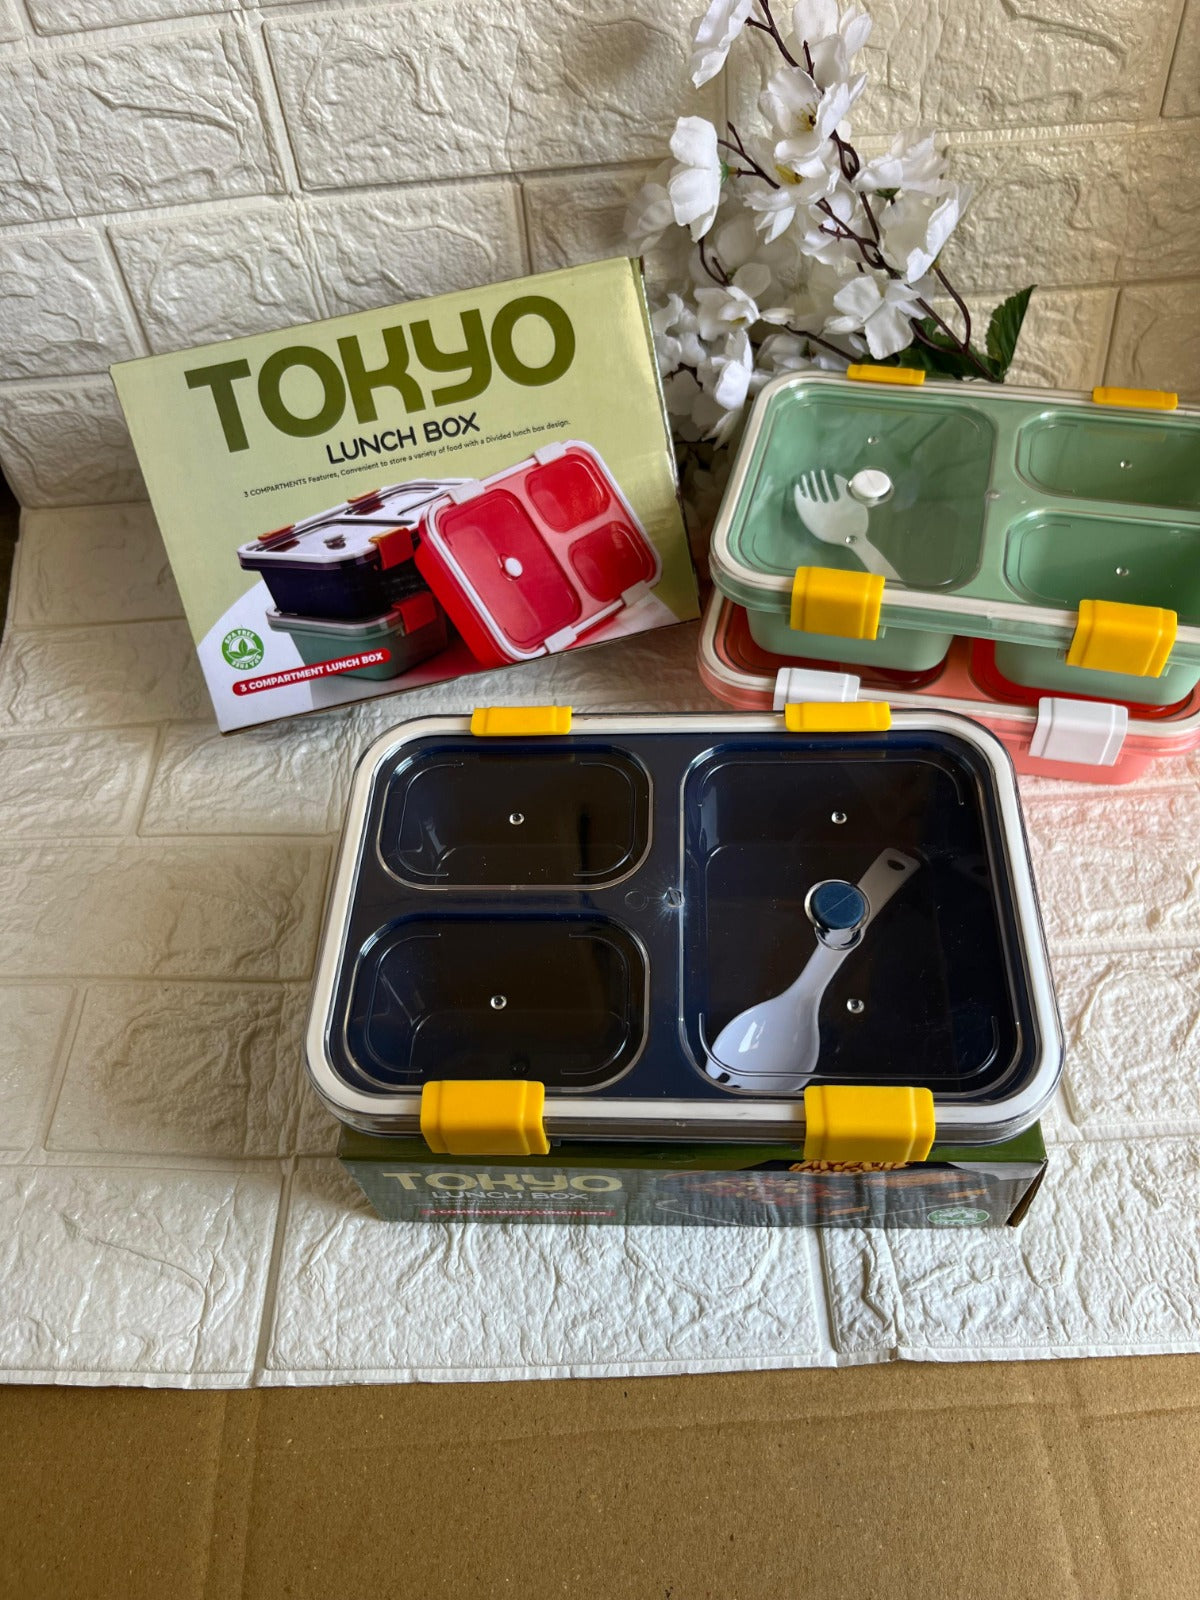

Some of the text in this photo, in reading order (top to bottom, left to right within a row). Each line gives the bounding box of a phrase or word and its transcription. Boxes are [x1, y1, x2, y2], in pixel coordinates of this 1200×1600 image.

[184, 295, 576, 453] TOKYO
[250, 478, 307, 497] COMPARTMENTS
[308, 472, 340, 484] Features,
[340, 462, 379, 476] Convenient
[380, 460, 388, 468] to
[389, 456, 407, 466] store
[413, 449, 437, 460] variety
[438, 446, 446, 454] of
[446, 443, 463, 452] food
[464, 440, 479, 449] with
[486, 432, 512, 443] Divided
[512, 428, 532, 438] lunch
[532, 424, 545, 433] box
[546, 418, 571, 430] design.
[326, 412, 480, 465] LUNCH BOX
[240, 652, 384, 692] 3 COMPARTMENT LUNCH BOX
[382, 1172, 623, 1193] TOKYO
[432, 1190, 589, 1200] LUNCH BOX
